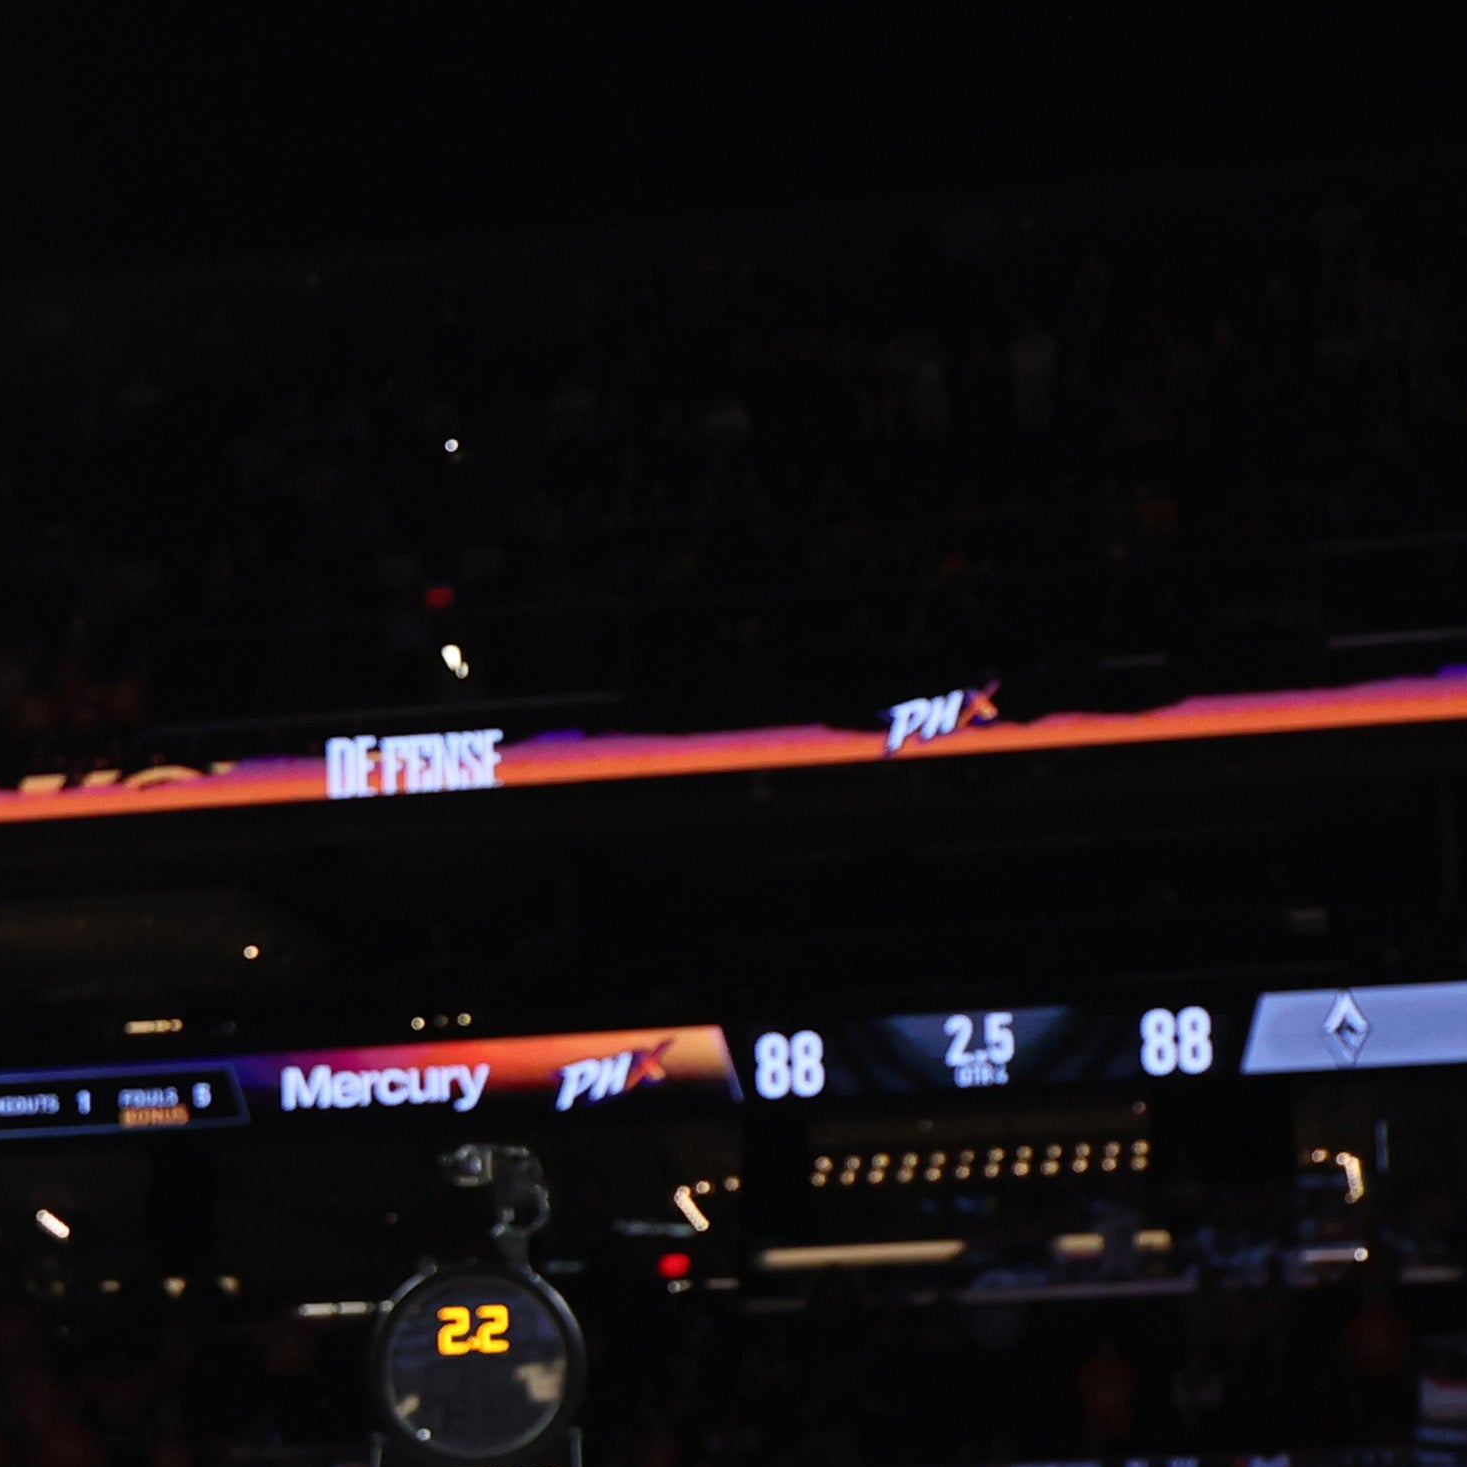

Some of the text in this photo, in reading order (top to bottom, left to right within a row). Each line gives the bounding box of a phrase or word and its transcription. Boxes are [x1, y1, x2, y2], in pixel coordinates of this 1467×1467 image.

[884, 680, 1001, 752] PHX
[326, 729, 504, 799] DEFENSE
[754, 1030, 826, 1100] 88
[943, 1011, 1015, 1067] 2.5
[1140, 1006, 1213, 1077] 88
[280, 1039, 674, 1113] Mercury PHX
